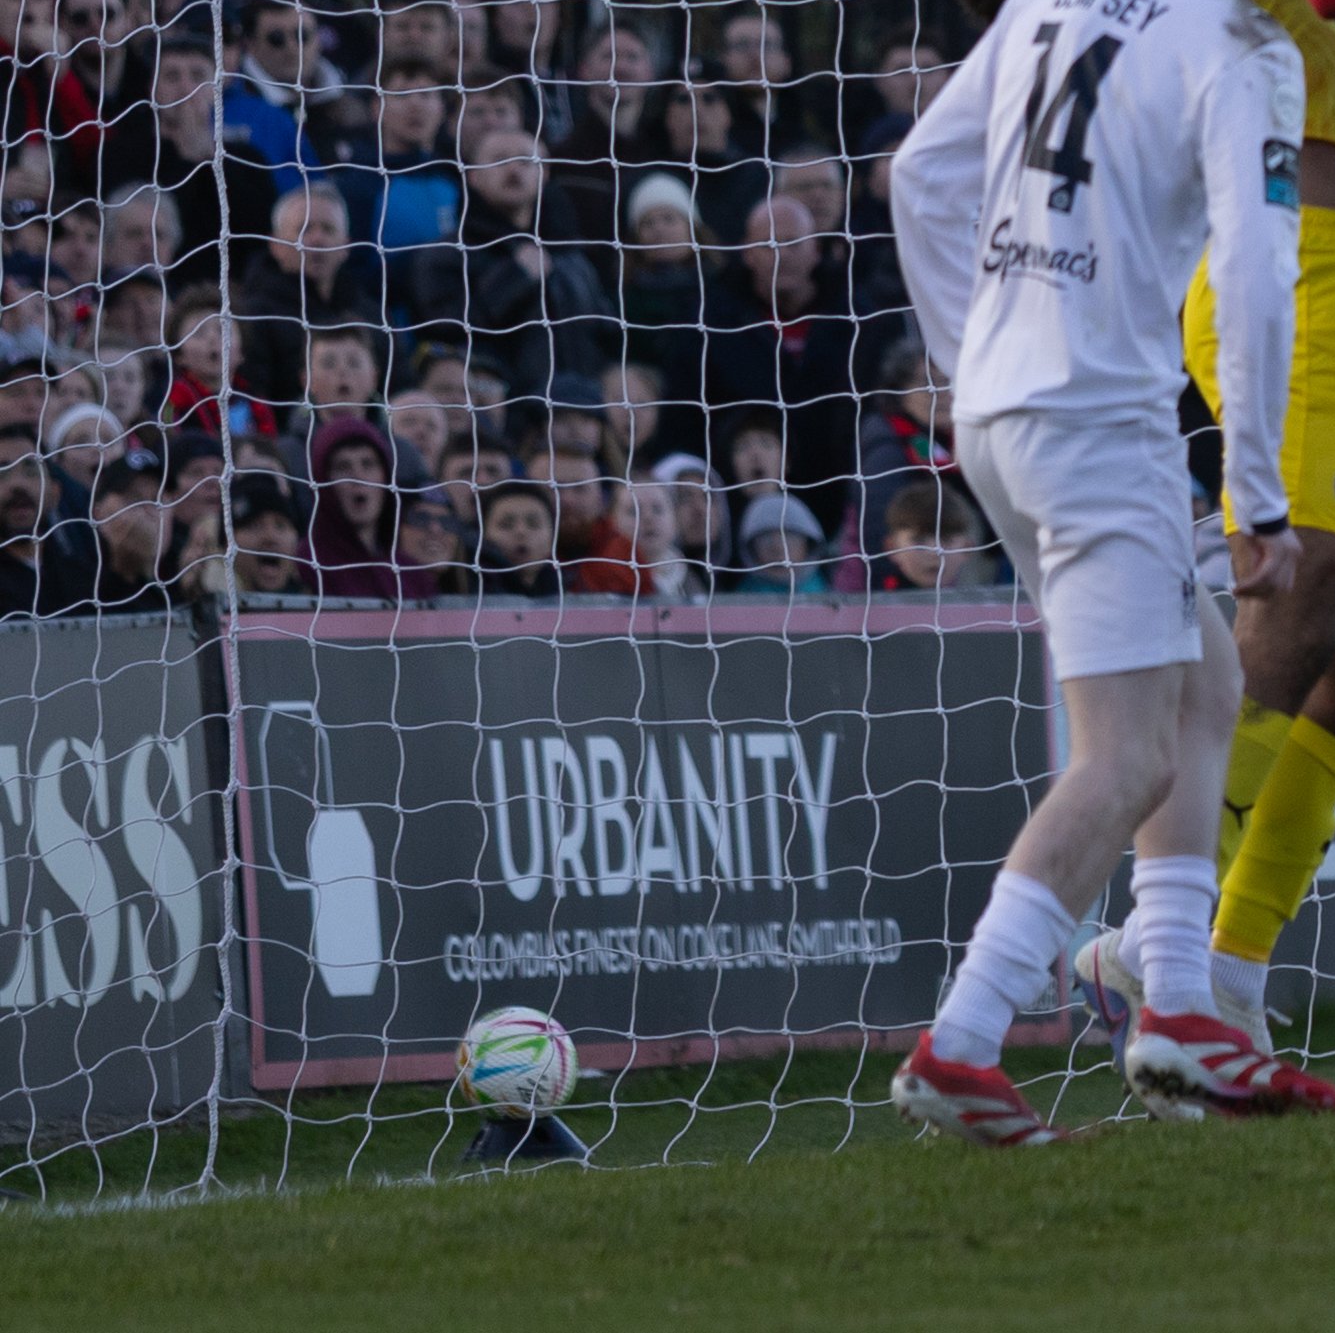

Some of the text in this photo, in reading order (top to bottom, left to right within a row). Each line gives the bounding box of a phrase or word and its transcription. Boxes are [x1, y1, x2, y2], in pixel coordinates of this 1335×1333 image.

[1020, 22, 1124, 213] 14
[489, 731, 835, 902] URBANITY
[642, 924, 677, 973] ON
